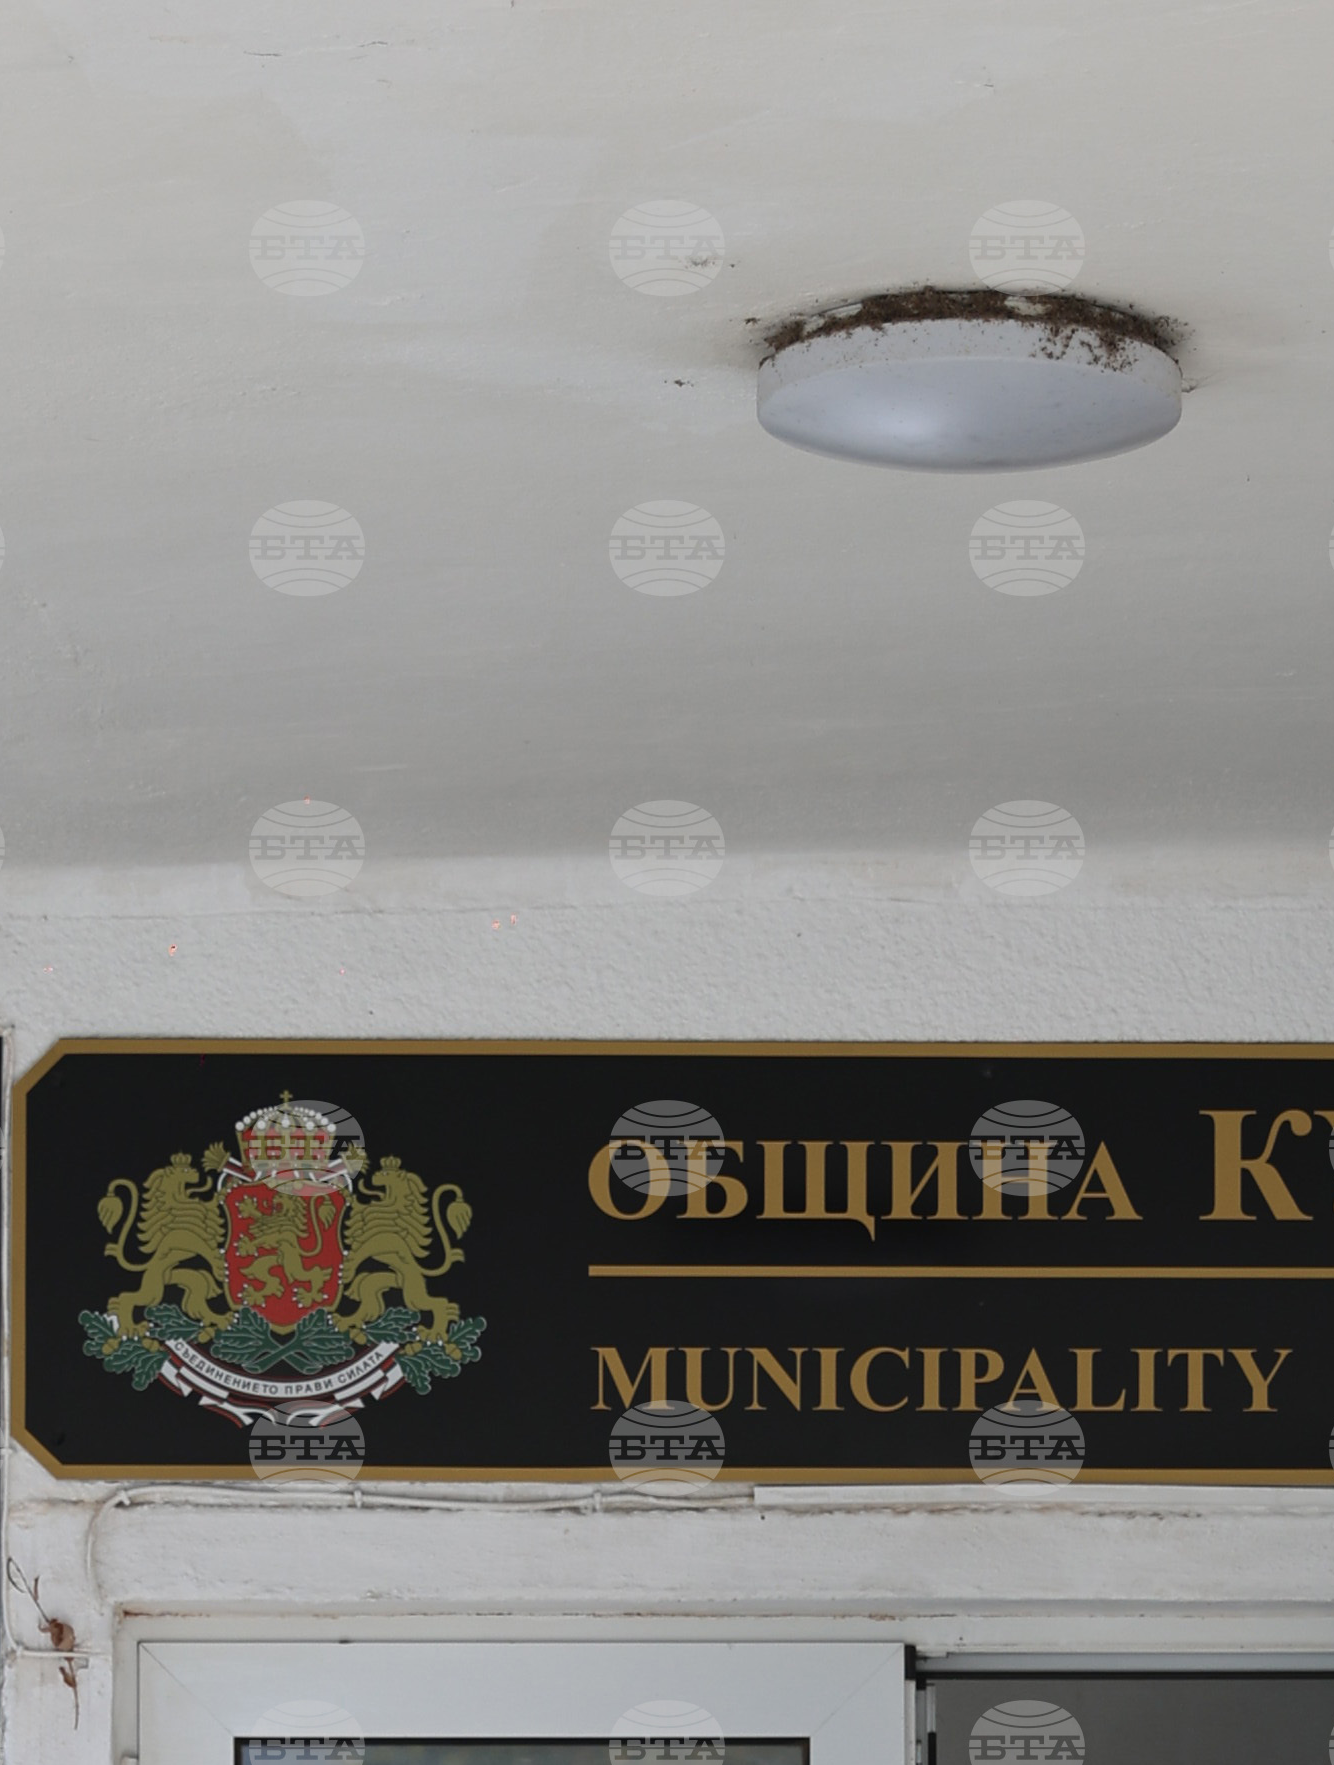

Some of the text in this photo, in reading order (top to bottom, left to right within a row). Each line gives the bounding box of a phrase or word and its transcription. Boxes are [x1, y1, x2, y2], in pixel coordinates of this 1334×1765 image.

[587, 1138, 1144, 1241] ОБЩИНА
[174, 1341, 385, 1396] СЪЕДИНЕНИЕТО ПРАВИ СИЛАТА
[588, 1345, 1295, 1413] MUNICIPALITY
